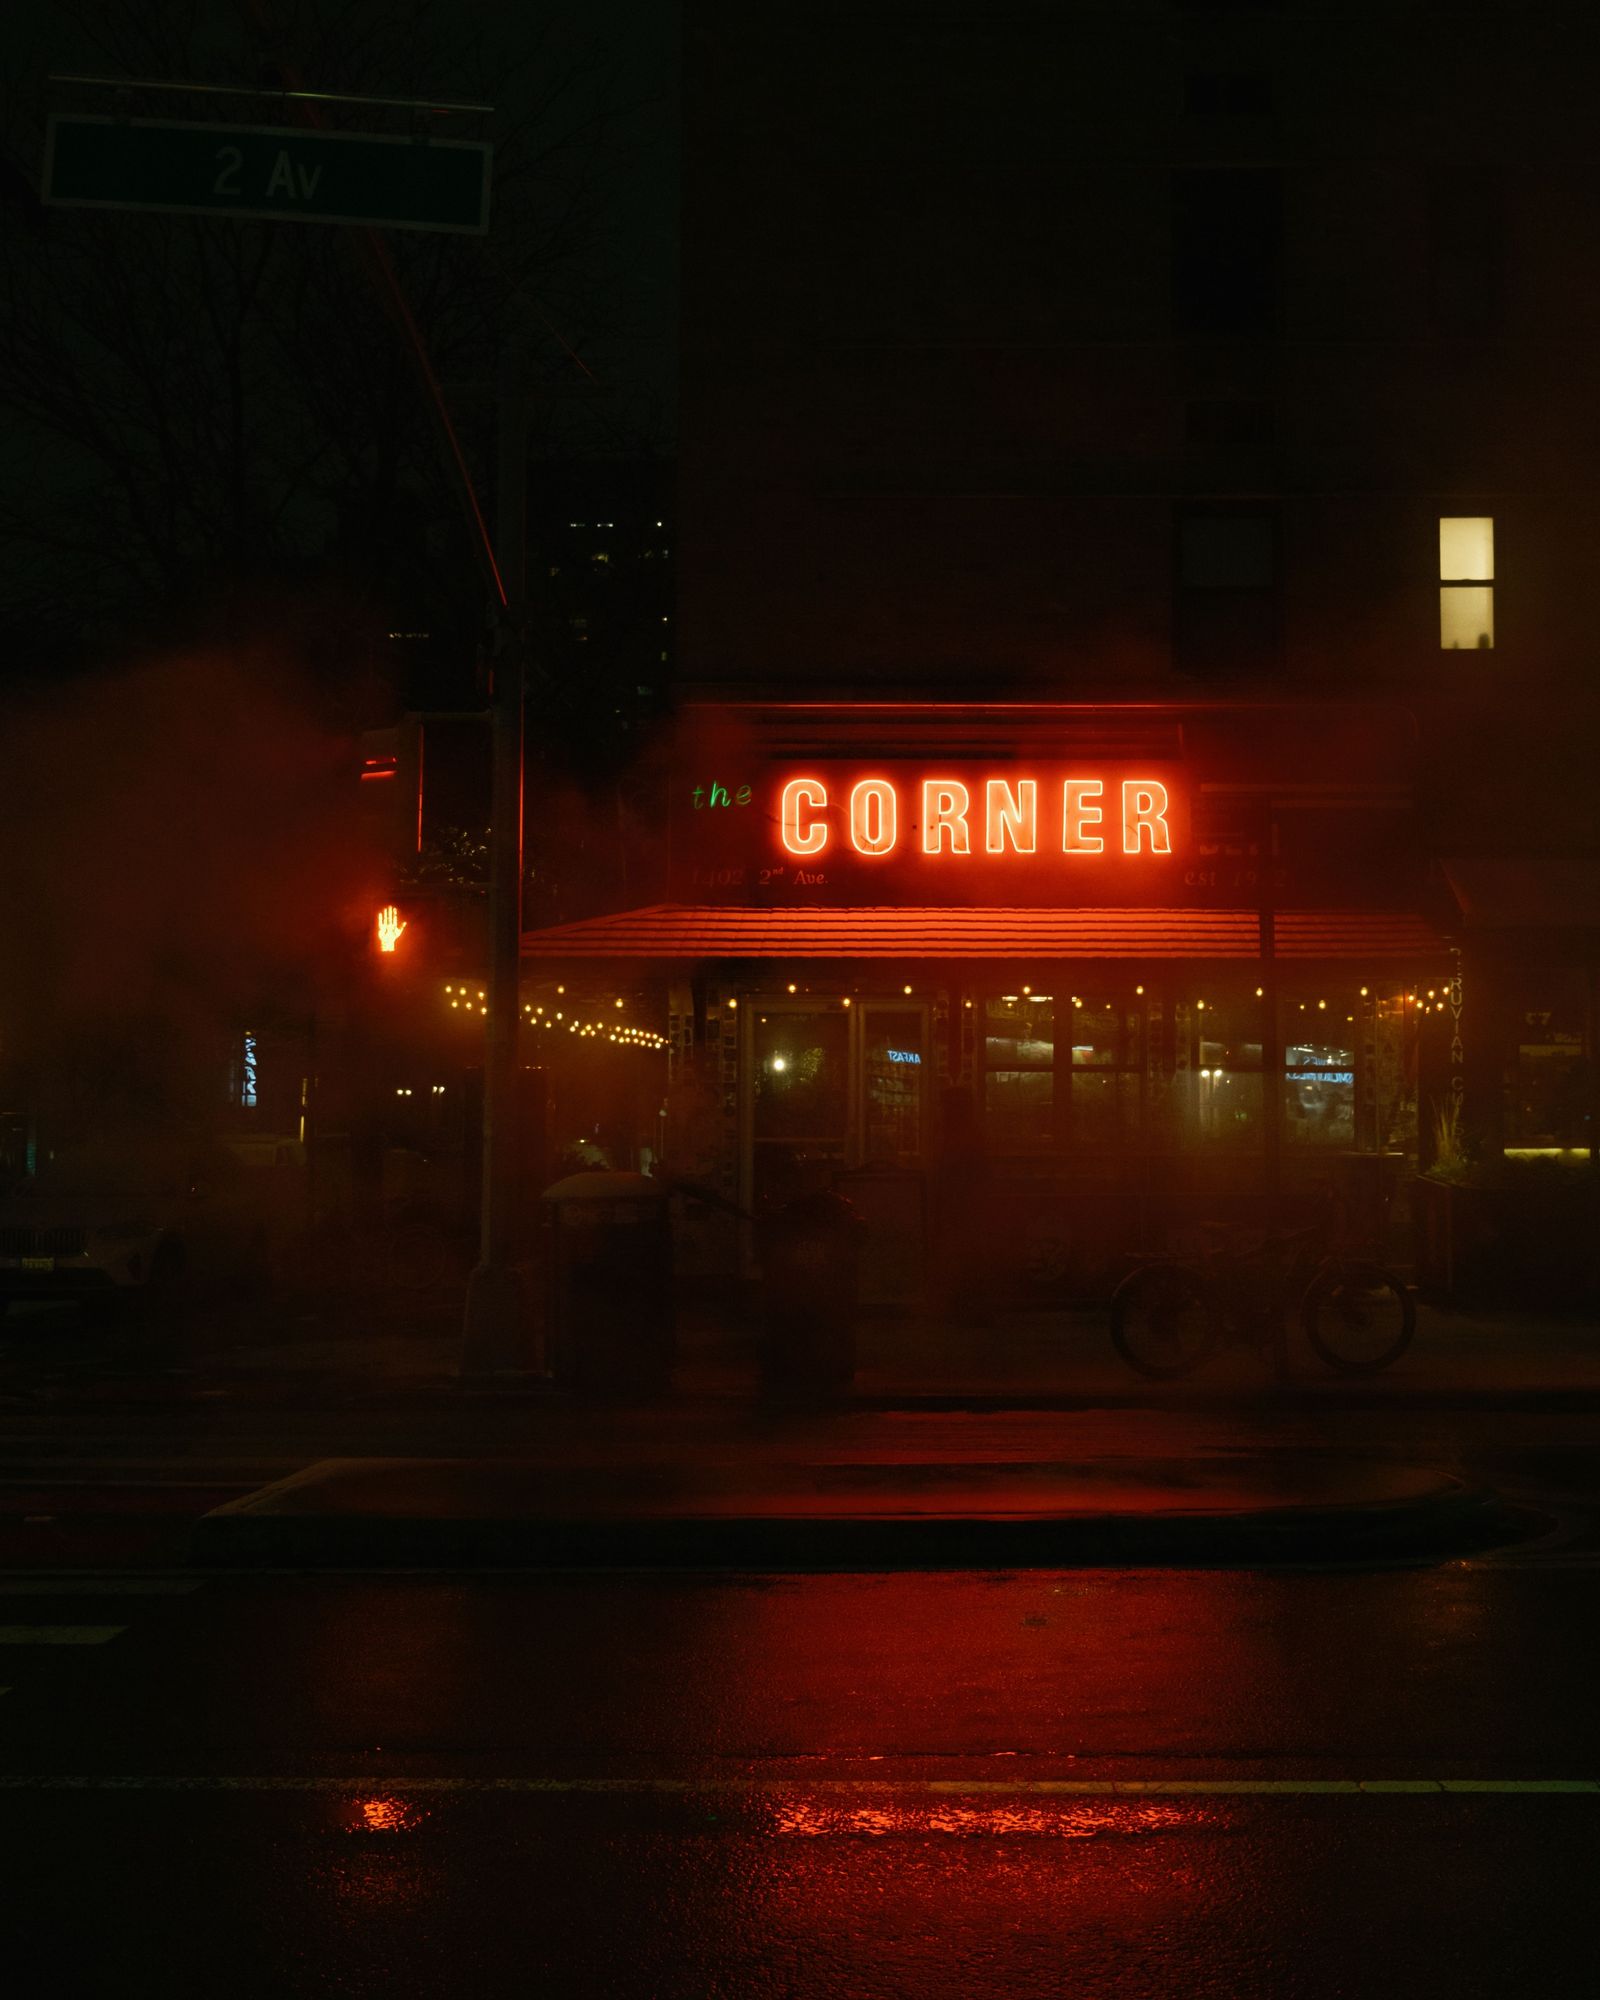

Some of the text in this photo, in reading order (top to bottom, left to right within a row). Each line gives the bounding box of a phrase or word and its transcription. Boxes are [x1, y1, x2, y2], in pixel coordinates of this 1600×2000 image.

[212, 145, 325, 200] 2 Av
[691, 779, 752, 809] the
[780, 778, 1173, 856] CORNER
[759, 866, 784, 885] 2nd
[793, 869, 829, 885] Ave.
